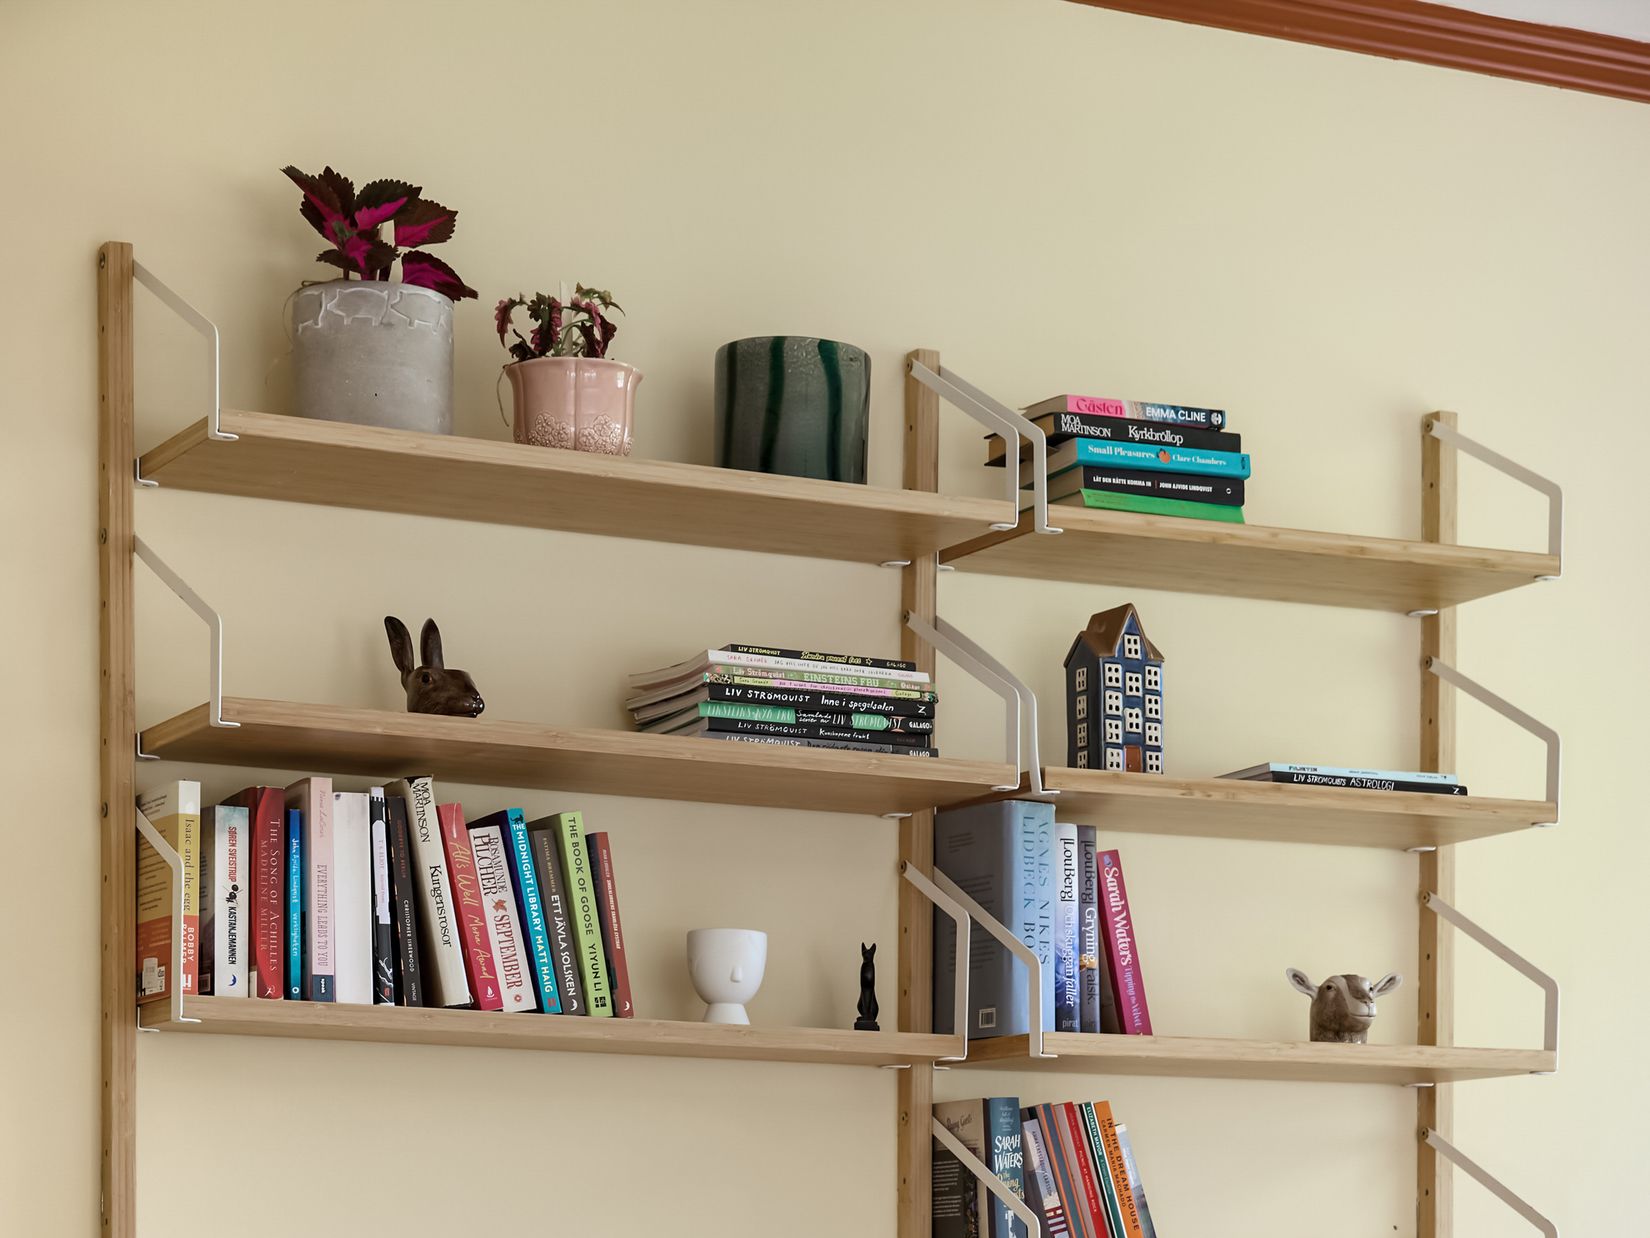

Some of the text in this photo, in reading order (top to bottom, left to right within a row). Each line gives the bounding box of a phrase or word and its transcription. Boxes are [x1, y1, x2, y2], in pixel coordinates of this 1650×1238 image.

[1061, 413, 1080, 426] MOA
[1061, 422, 1111, 437] MARTINSON
[1076, 398, 1123, 416] Gästen
[1145, 406, 1206, 423] EMMA CLINE
[1088, 444, 1156, 460] Small Pleasures
[1128, 425, 1183, 446] Kyrkbröllop
[1172, 453, 1191, 463] Clare
[1191, 455, 1227, 466] Chambers
[725, 688, 811, 702] LIV STRÖMQUIST
[803, 673, 858, 686] EINSTEINS
[860, 678, 880, 688] FRU
[820, 695, 840, 707] Inne
[848, 700, 895, 712] spegelsalen
[737, 722, 808, 735] LIV STRÖMQUIST
[832, 714, 846, 726] LIV
[909, 721, 930, 730] GALAGO
[419, 782, 431, 806] MOA
[1293, 773, 1395, 791] LIV ASTROLOGI
[412, 783, 430, 843] MARTINSON
[184, 818, 195, 912] Isaac and the egg
[228, 826, 238, 882] SØREN SVEISTRUP
[449, 842, 479, 905] All's Well
[472, 834, 498, 896] PILCHER
[490, 836, 508, 894] ROSAMUNDE
[542, 837, 552, 862] FATIMA
[1022, 816, 1035, 910] LIDBECK
[260, 840, 269, 951] MADELINE MILLER
[269, 818, 281, 972] THE SONG OF ACHILLES
[516, 831, 542, 932] MIDNIGHT LIBRARY
[568, 816, 594, 936] THE BOOK OF GOOSE
[1038, 820, 1050, 966] AGNES NIKES
[228, 906, 238, 964] KASTANJEMANNEN
[316, 864, 328, 967] EVERYTHING LEADS TO YOU
[403, 900, 416, 972] CHRISTOPHER ISHERWOOD
[1104, 866, 1134, 966] Sarah Waters
[468, 914, 495, 980] Mona Awad
[494, 914, 524, 990] SEPTEMBER
[535, 936, 554, 993] MATT HAIG
[550, 894, 576, 996] ETT JÄVLA SOLSKEN
[588, 943, 602, 992] YIYUN LI
[1060, 906, 1076, 1007] Och skuggan faller
[1122, 966, 1137, 996] Tipping
[1130, 1004, 1142, 1026] Velvet
[994, 1134, 1021, 1154] SARAH
[1086, 1106, 1104, 1156] ELIZABETH MAVOR
[1106, 1117, 1116, 1130] IN
[1110, 1132, 1121, 1152] THE
[994, 1152, 1024, 1174] WATERS
[1101, 1120, 1127, 1208] CARMEN MARIA MACHADO
[1116, 1155, 1130, 1192] DREAM
[1084, 1176, 1094, 1198] HANGING
[1090, 1198, 1098, 1213] ROCK
[1126, 1196, 1140, 1232] HOUSE
